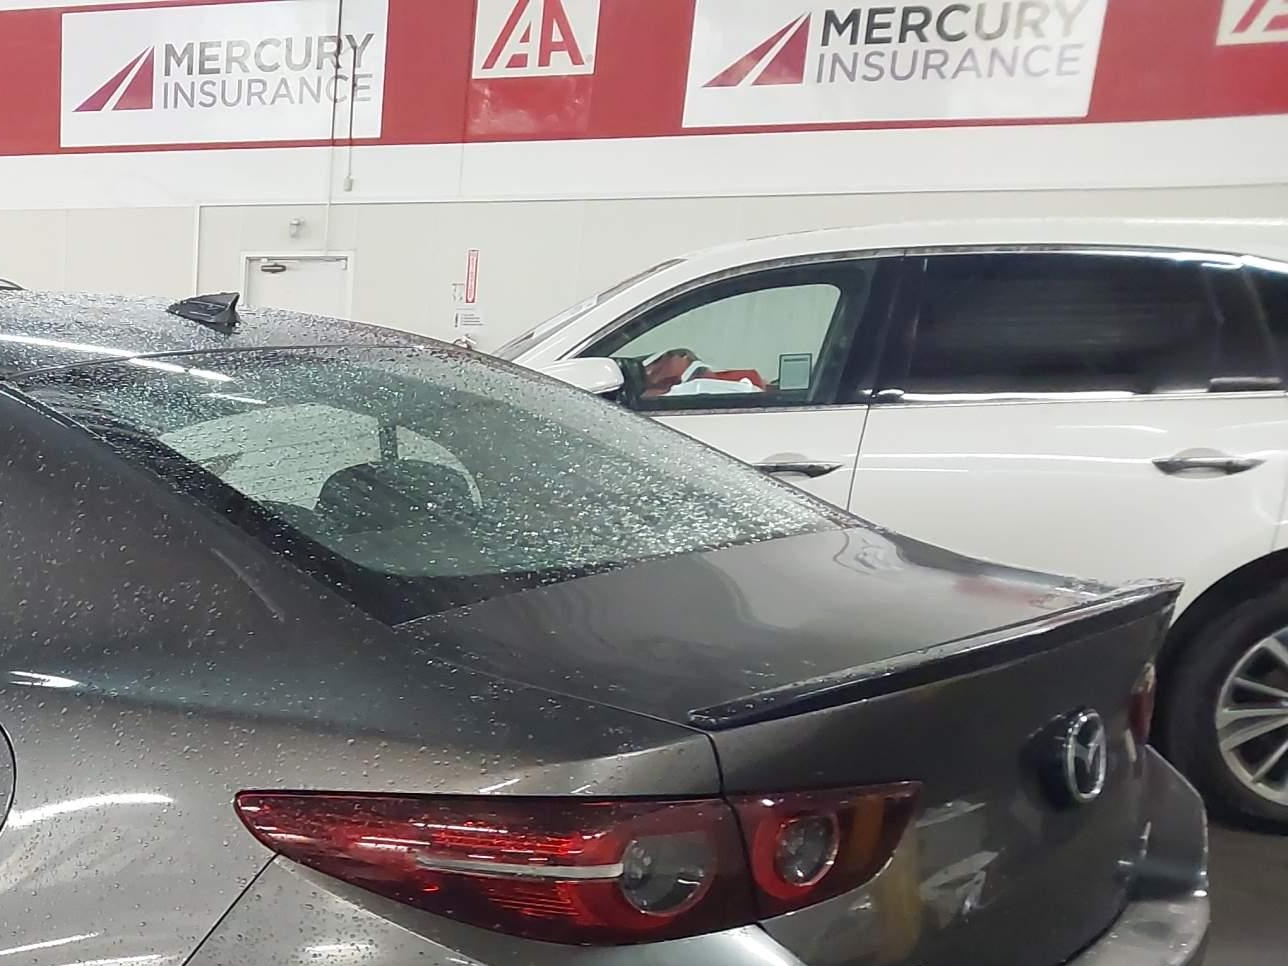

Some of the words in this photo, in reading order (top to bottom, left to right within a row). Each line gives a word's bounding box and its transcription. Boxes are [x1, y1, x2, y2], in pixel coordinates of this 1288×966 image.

[821, 0, 1089, 46] MERCURY
[164, 33, 374, 76] MERCURY
[816, 43, 1085, 83] INSURANCE
[163, 74, 373, 109] INSURANCE
